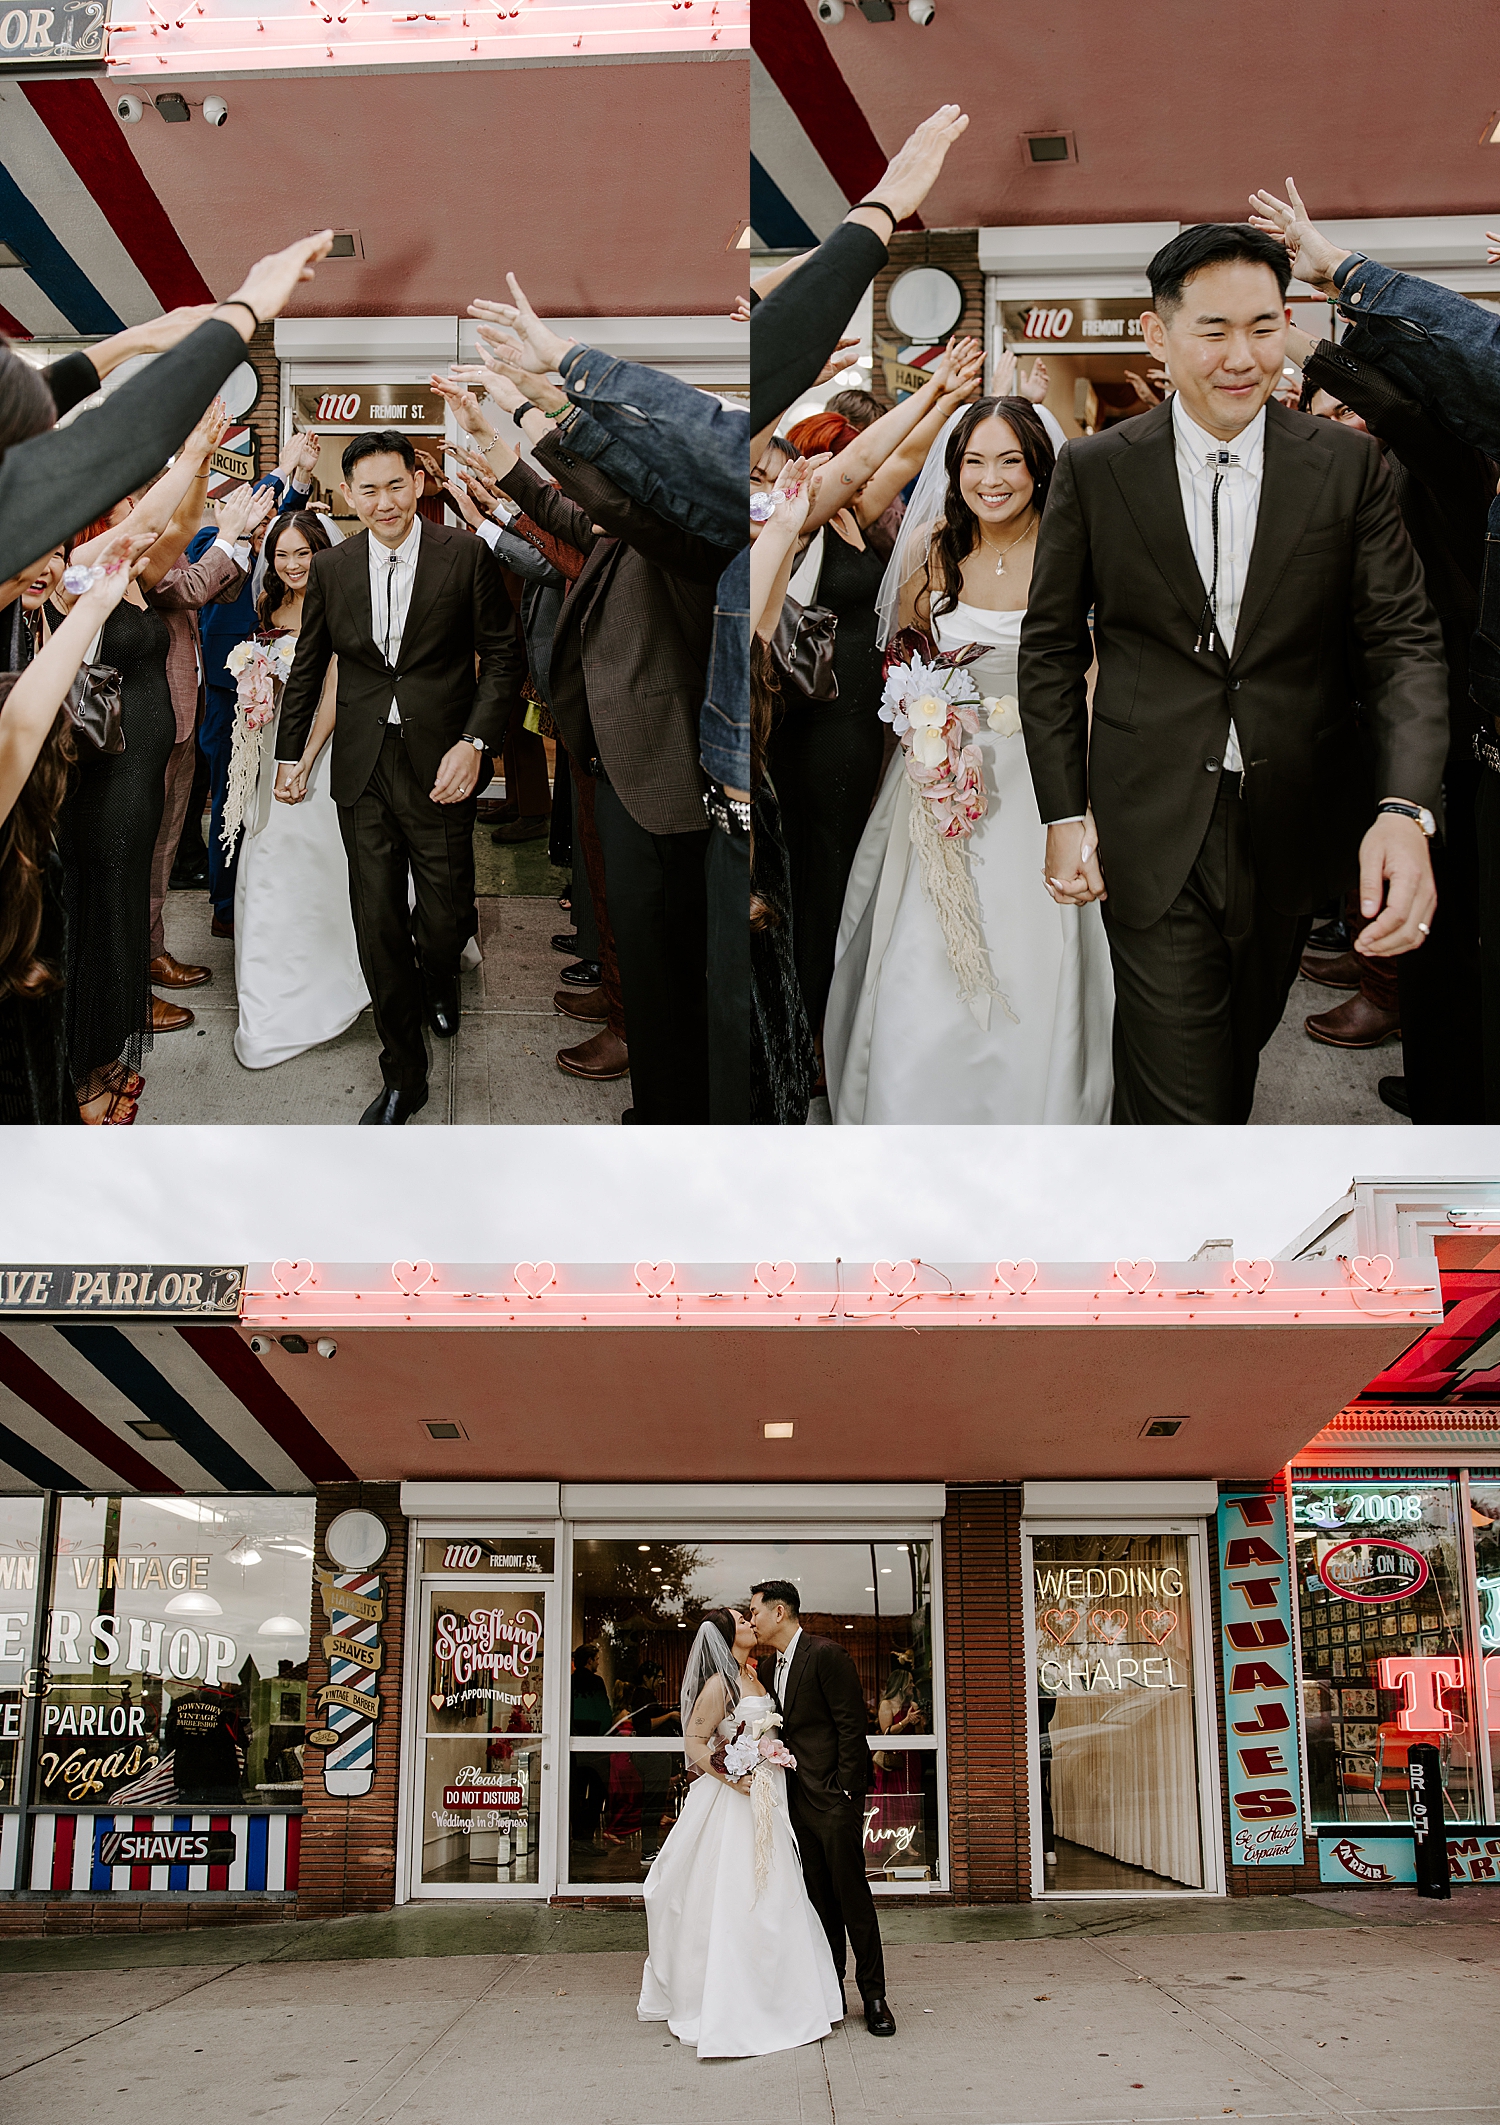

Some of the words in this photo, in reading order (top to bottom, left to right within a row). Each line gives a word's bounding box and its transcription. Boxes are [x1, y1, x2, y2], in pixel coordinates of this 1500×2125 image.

[1023, 307, 1074, 340] 1110
[1081, 318, 1125, 336] FREMONT
[895, 369, 930, 389] HAIR
[315, 392, 361, 422] 1110
[369, 404, 408, 419] FREMONT
[411, 404, 425, 419] ST.
[210, 452, 248, 476] IRCUTS
[0, 1271, 53, 1304] VE
[68, 1271, 203, 1305] PARLOR
[442, 1544, 482, 1569] 1110
[489, 1554, 523, 1568] FREMONT
[1330, 1558, 1374, 1581] COME
[1376, 1555, 1395, 1574] ON
[1398, 1556, 1415, 1577] IN
[72, 1557, 210, 1590] VINTAGE
[1035, 1567, 1184, 1600] WEDDING
[332, 1639, 375, 1665] SHAVES
[453, 1643, 529, 1685] Chapel
[1224, 1494, 1298, 1822] TATUAJES
[1040, 1656, 1188, 1691] CHAPEL
[177, 1702, 223, 1715] DOWNTOWN
[325, 1689, 350, 1702] VINTAGE
[353, 1694, 376, 1713] BARBER
[446, 1692, 460, 1707] BY
[461, 1688, 522, 1706] APPOINTMENT
[0, 1703, 21, 1736] E
[43, 1705, 146, 1737] PARLOR
[176, 1719, 218, 1728] BARBERSHOP
[179, 1712, 218, 1721] VINTAGE
[40, 1744, 159, 1801] Vegas
[455, 1765, 517, 1787] Please
[446, 1791, 460, 1804] DO
[461, 1791, 481, 1804] NOT
[482, 1791, 521, 1805] DISTURB
[1409, 1763, 1430, 1846] BRIGHT
[431, 1810, 475, 1835] Weddings
[476, 1815, 486, 1828] in
[486, 1810, 528, 1835] Progress
[1235, 1828, 1253, 1846] Se
[1255, 1821, 1299, 1844] Habla
[120, 1836, 209, 1860] SHAVES
[1243, 1838, 1297, 1865] Español
[1339, 1844, 1354, 1860] IN
[1348, 1859, 1383, 1879] REAR
[1447, 1855, 1500, 1882] AR
